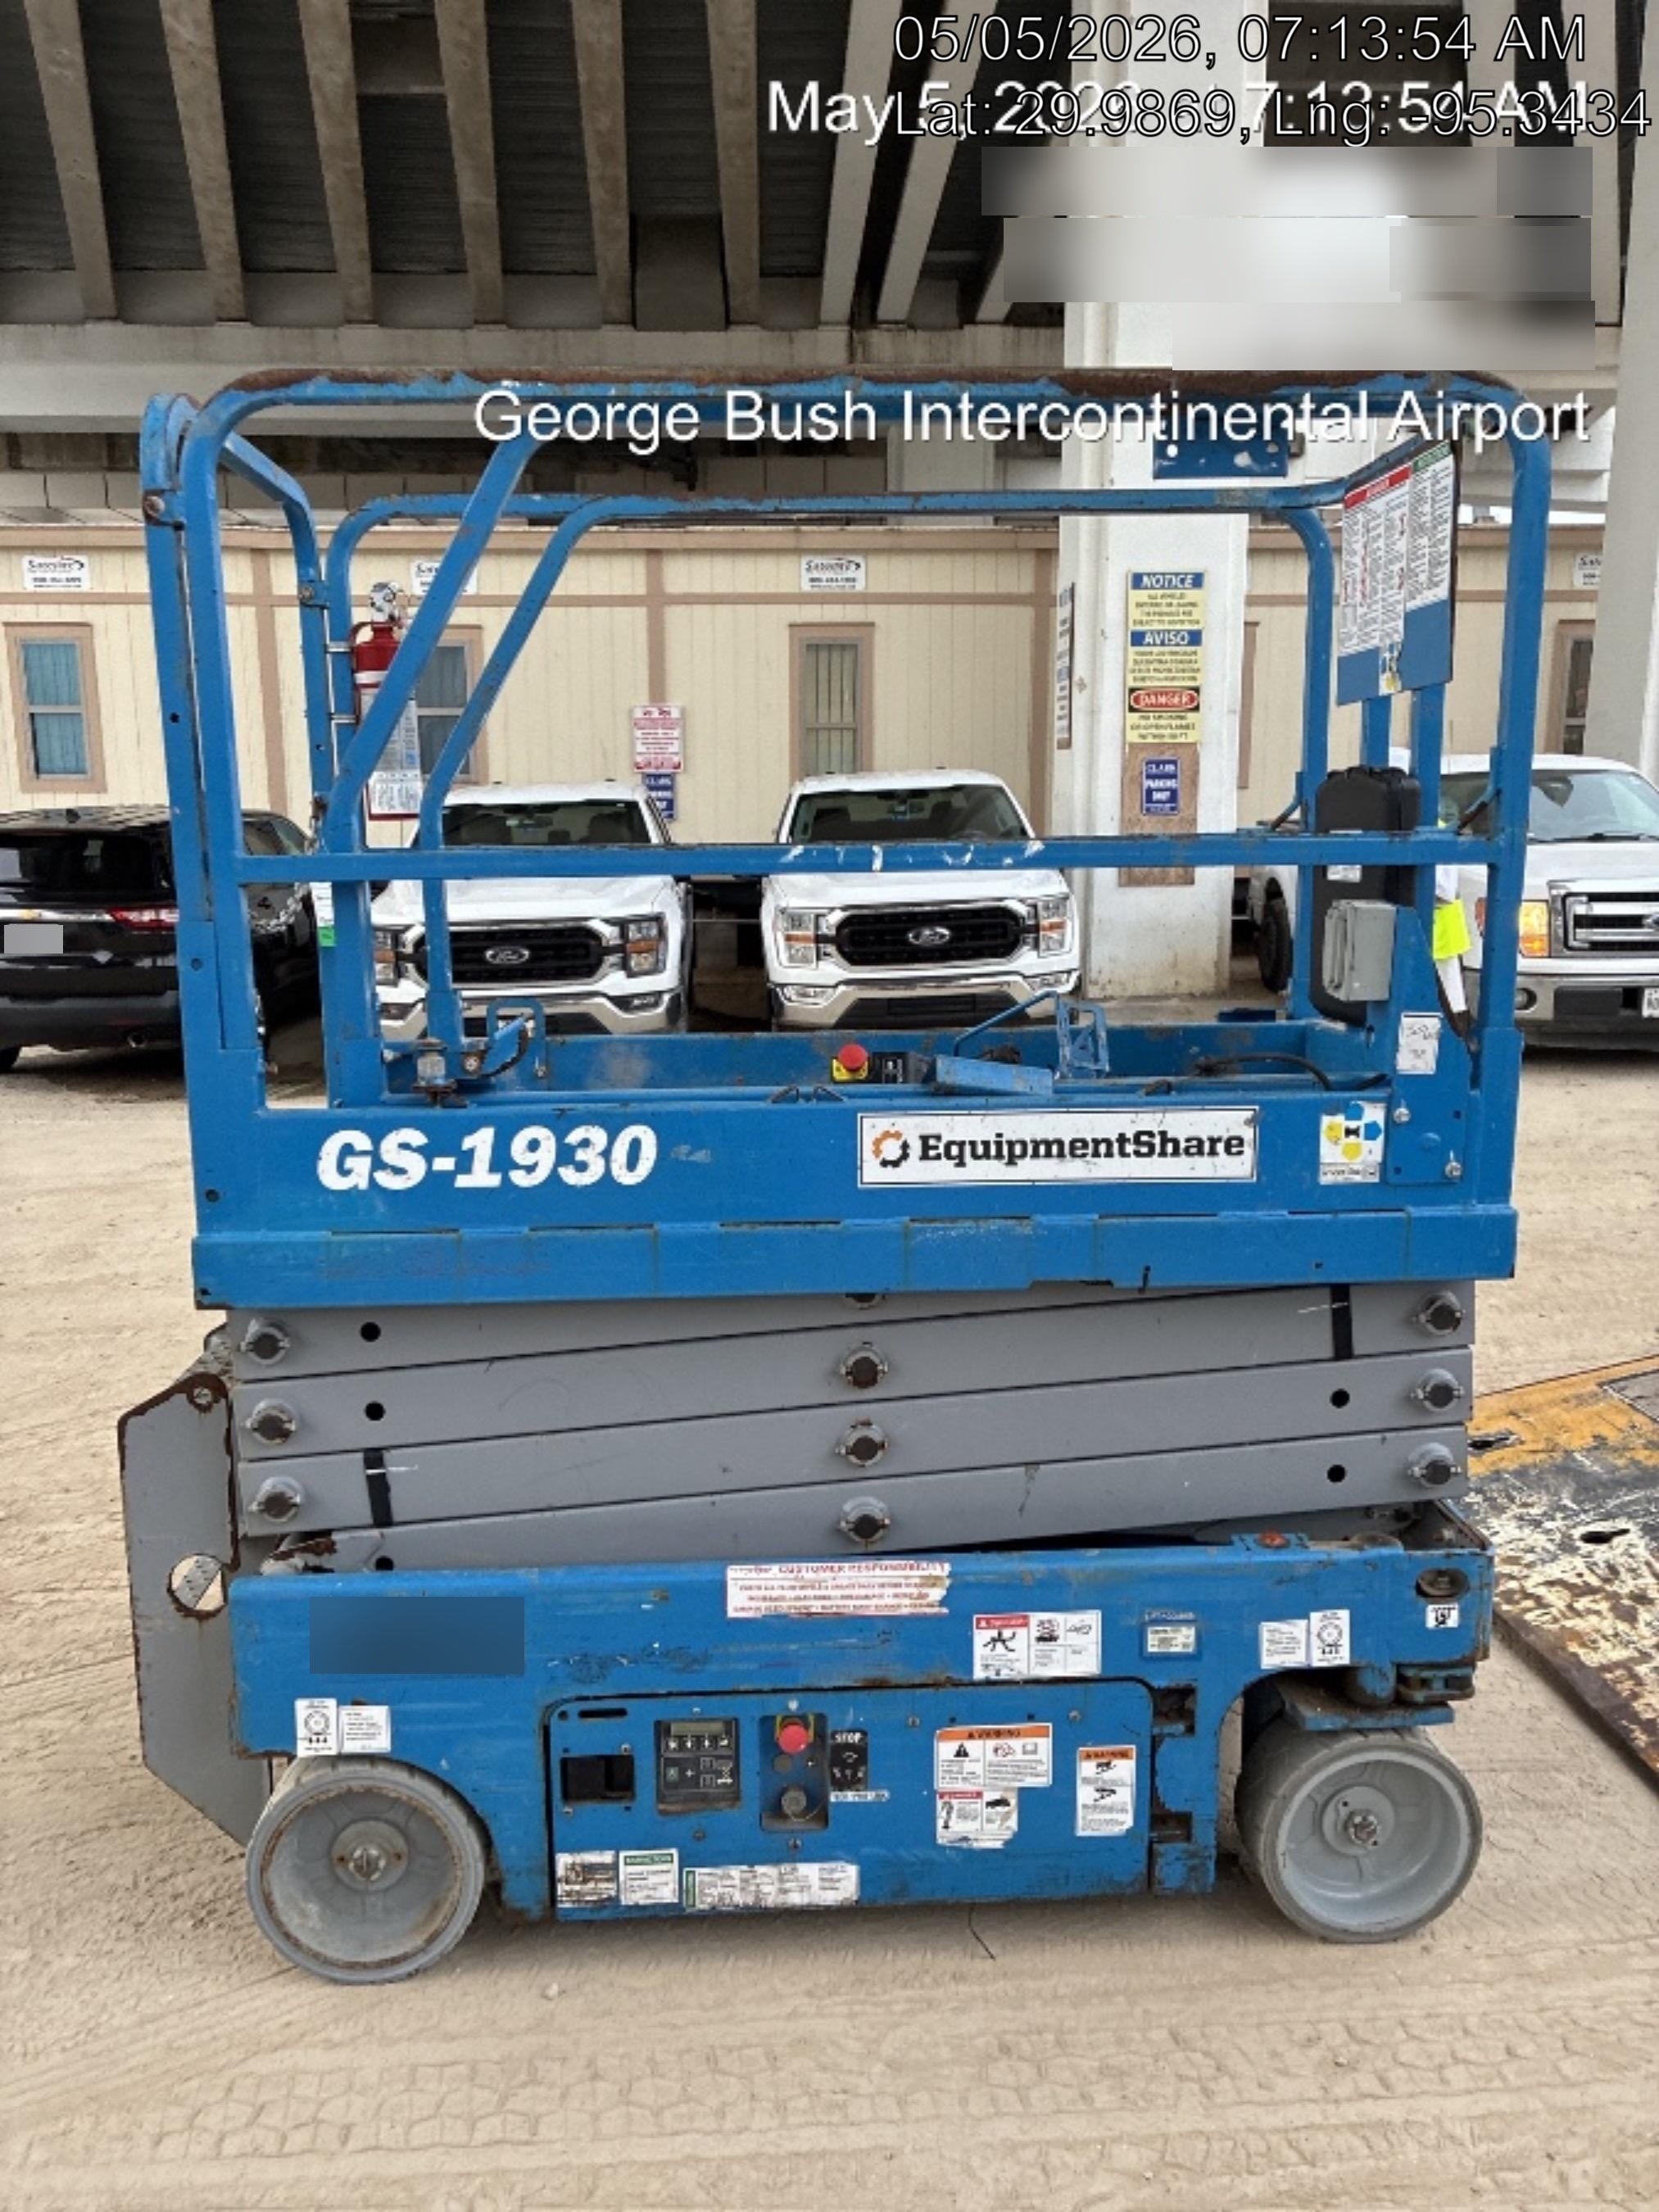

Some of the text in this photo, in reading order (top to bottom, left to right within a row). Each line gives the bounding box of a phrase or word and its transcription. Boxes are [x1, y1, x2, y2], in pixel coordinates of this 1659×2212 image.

[1140, 575, 1195, 588] NOTICE
[1143, 632, 1190, 645] AVISO
[1140, 692, 1190, 707] DANGER
[918, 1130, 1245, 1168] EquipmentShare
[316, 1124, 659, 1191] GS-1930
[834, 1732, 863, 1743] STOP
